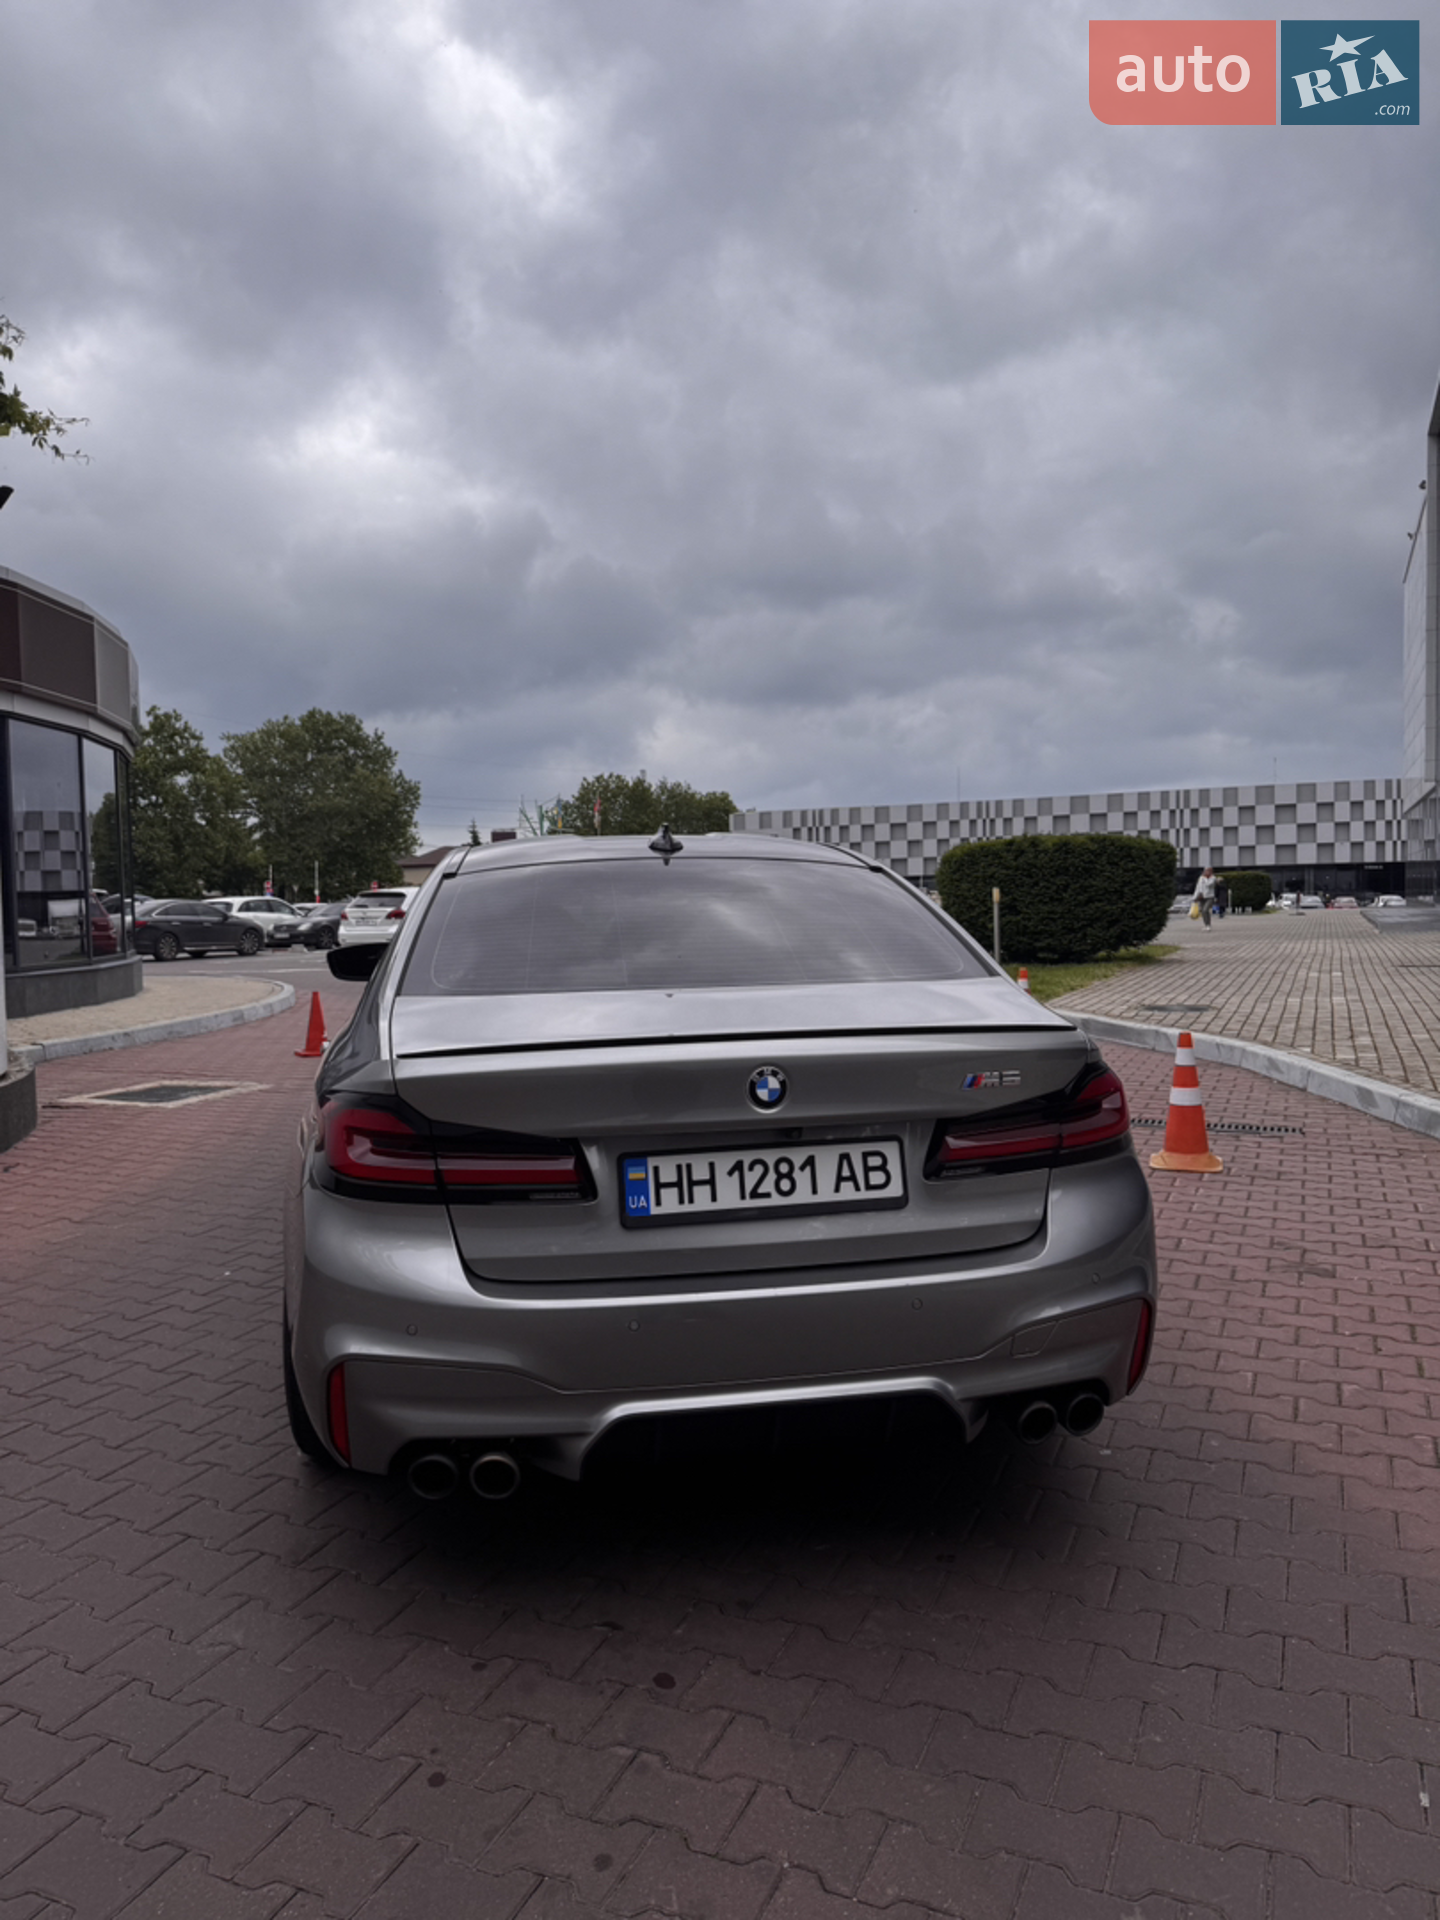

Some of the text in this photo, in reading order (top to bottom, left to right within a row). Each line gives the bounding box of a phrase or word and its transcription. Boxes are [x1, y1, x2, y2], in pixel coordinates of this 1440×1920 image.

[653, 1150, 892, 1207] HH 1281 AB
[629, 1195, 648, 1209] UA
